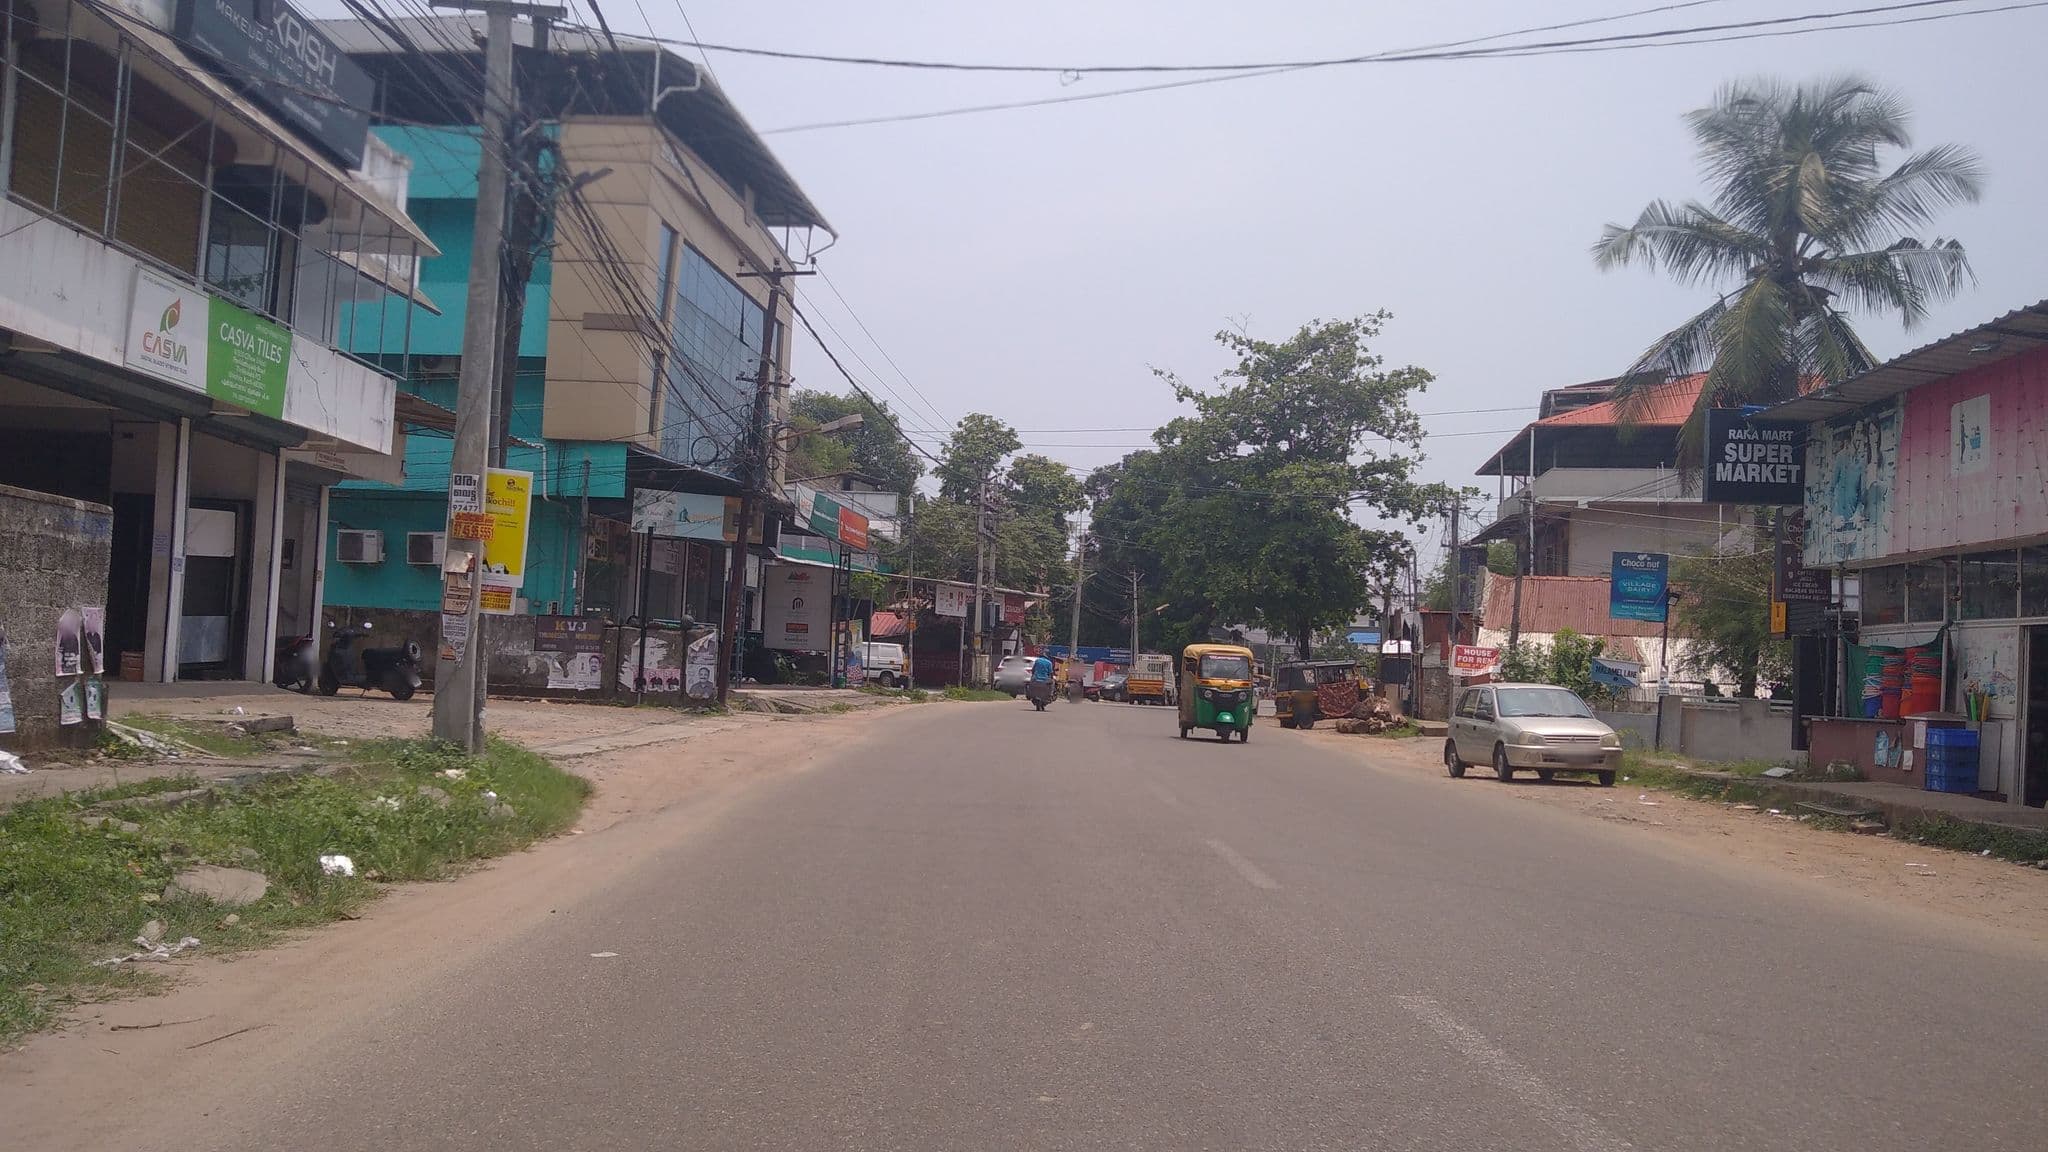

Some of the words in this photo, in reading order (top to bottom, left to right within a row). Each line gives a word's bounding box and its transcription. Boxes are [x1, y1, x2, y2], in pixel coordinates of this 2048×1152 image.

[143, 331, 188, 366] CASVA
[220, 322, 255, 353] CASVA
[257, 338, 283, 364] TILES
[1762, 429, 1794, 442] MART
[1724, 442, 1794, 465] SUPER
[1715, 462, 1801, 484] MARKET
[1621, 558, 1645, 568] Choco
[555, 621, 588, 632] KVJ
[1457, 655, 1475, 663] FOR
[1463, 648, 1493, 657] HOUSE
